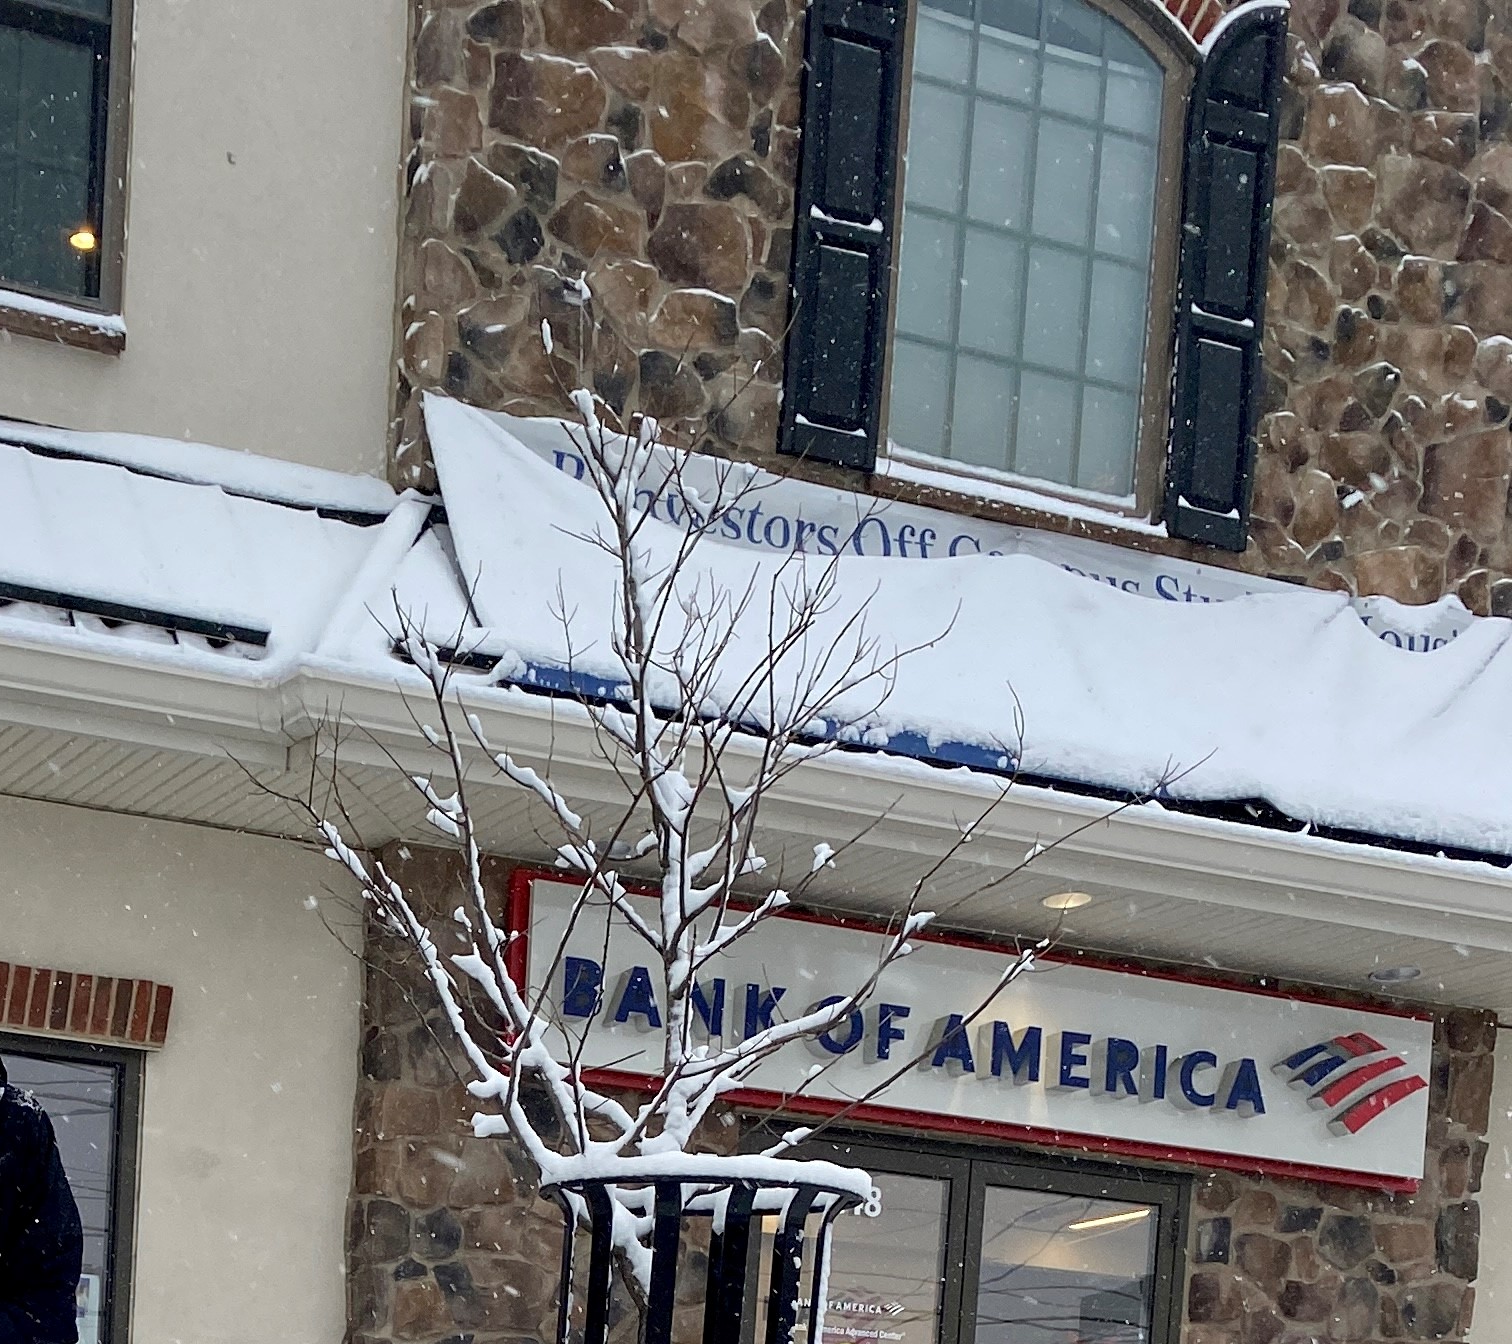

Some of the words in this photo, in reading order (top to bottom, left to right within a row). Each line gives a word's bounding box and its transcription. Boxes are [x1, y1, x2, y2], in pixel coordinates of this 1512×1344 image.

[610, 482, 840, 556] nvestors
[563, 956, 787, 1041] BANK
[815, 995, 911, 1061] OF
[931, 1013, 1266, 1114] AMERICA
[835, 1301, 882, 1315] AMERICA
